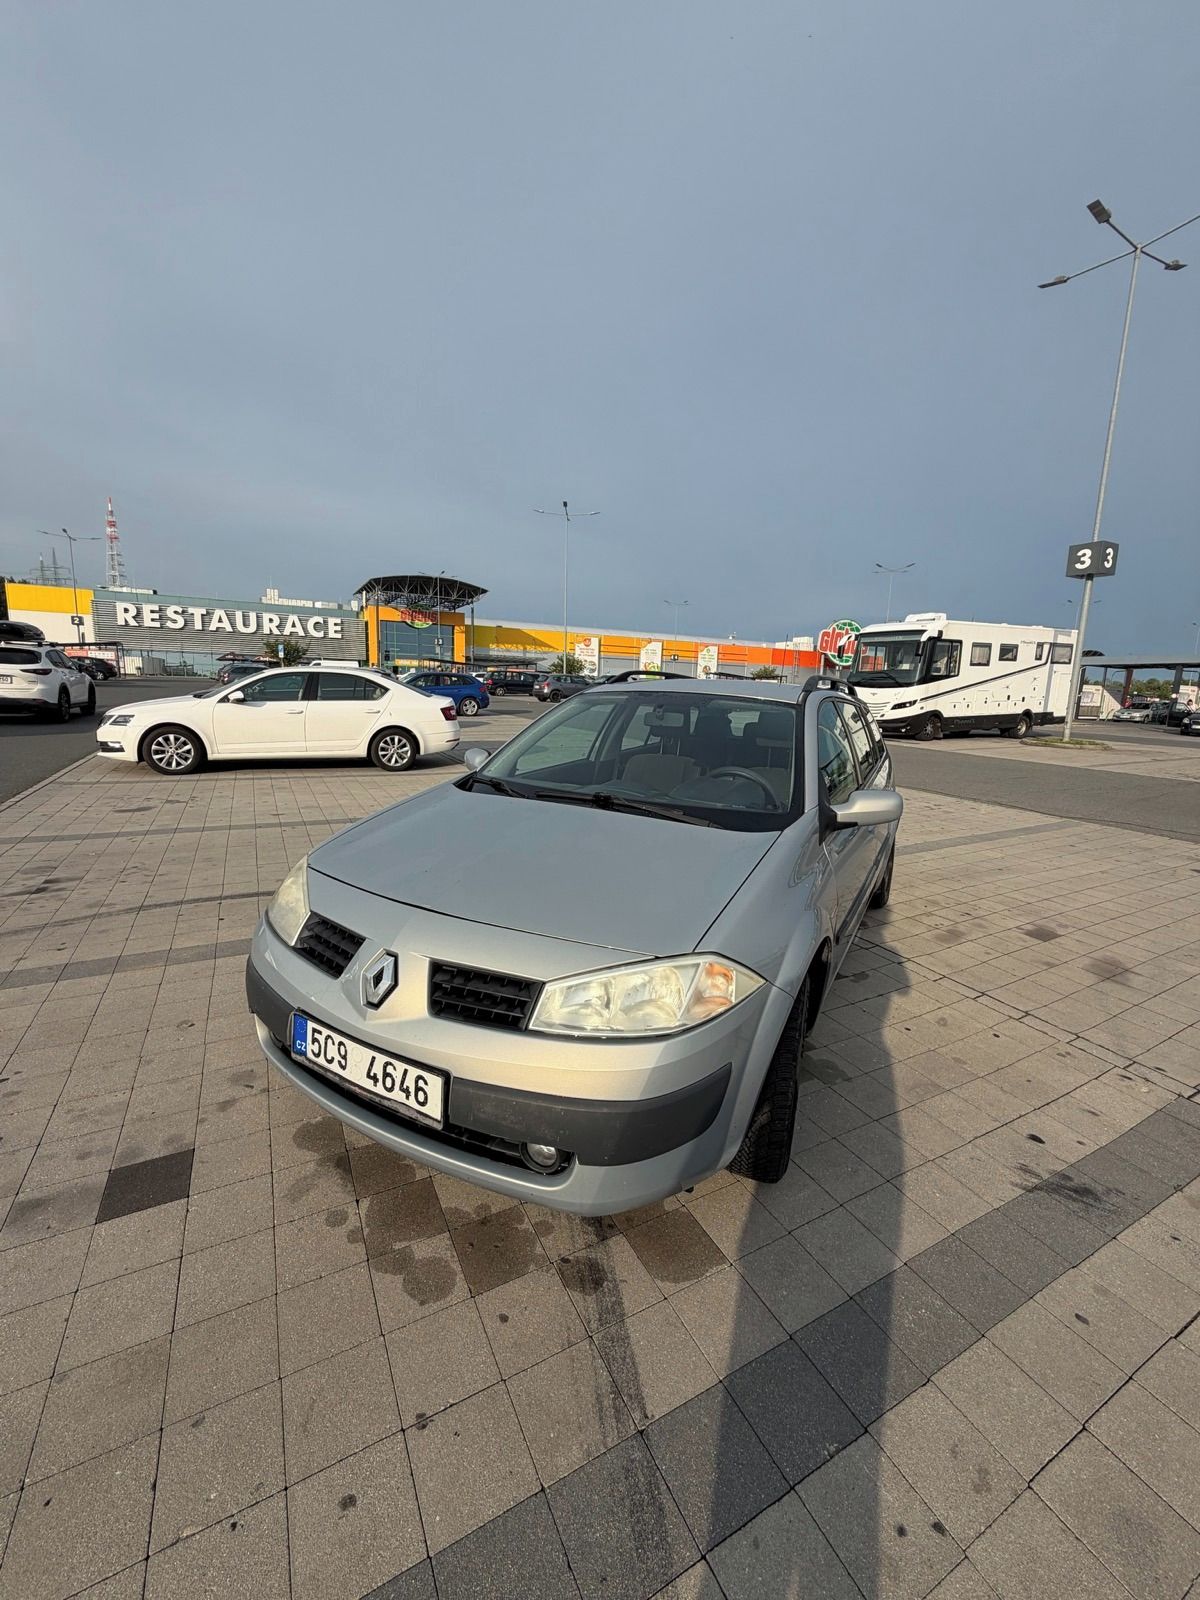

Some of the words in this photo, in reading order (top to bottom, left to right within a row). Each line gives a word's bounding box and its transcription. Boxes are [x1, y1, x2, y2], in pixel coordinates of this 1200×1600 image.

[1075, 549, 1092, 569] 3
[1104, 548, 1114, 568] 3
[116, 602, 342, 638] RESTAURACE
[296, 1040, 306, 1052] CZ
[311, 1027, 348, 1071] 5C9
[366, 1056, 429, 1107] 4646
